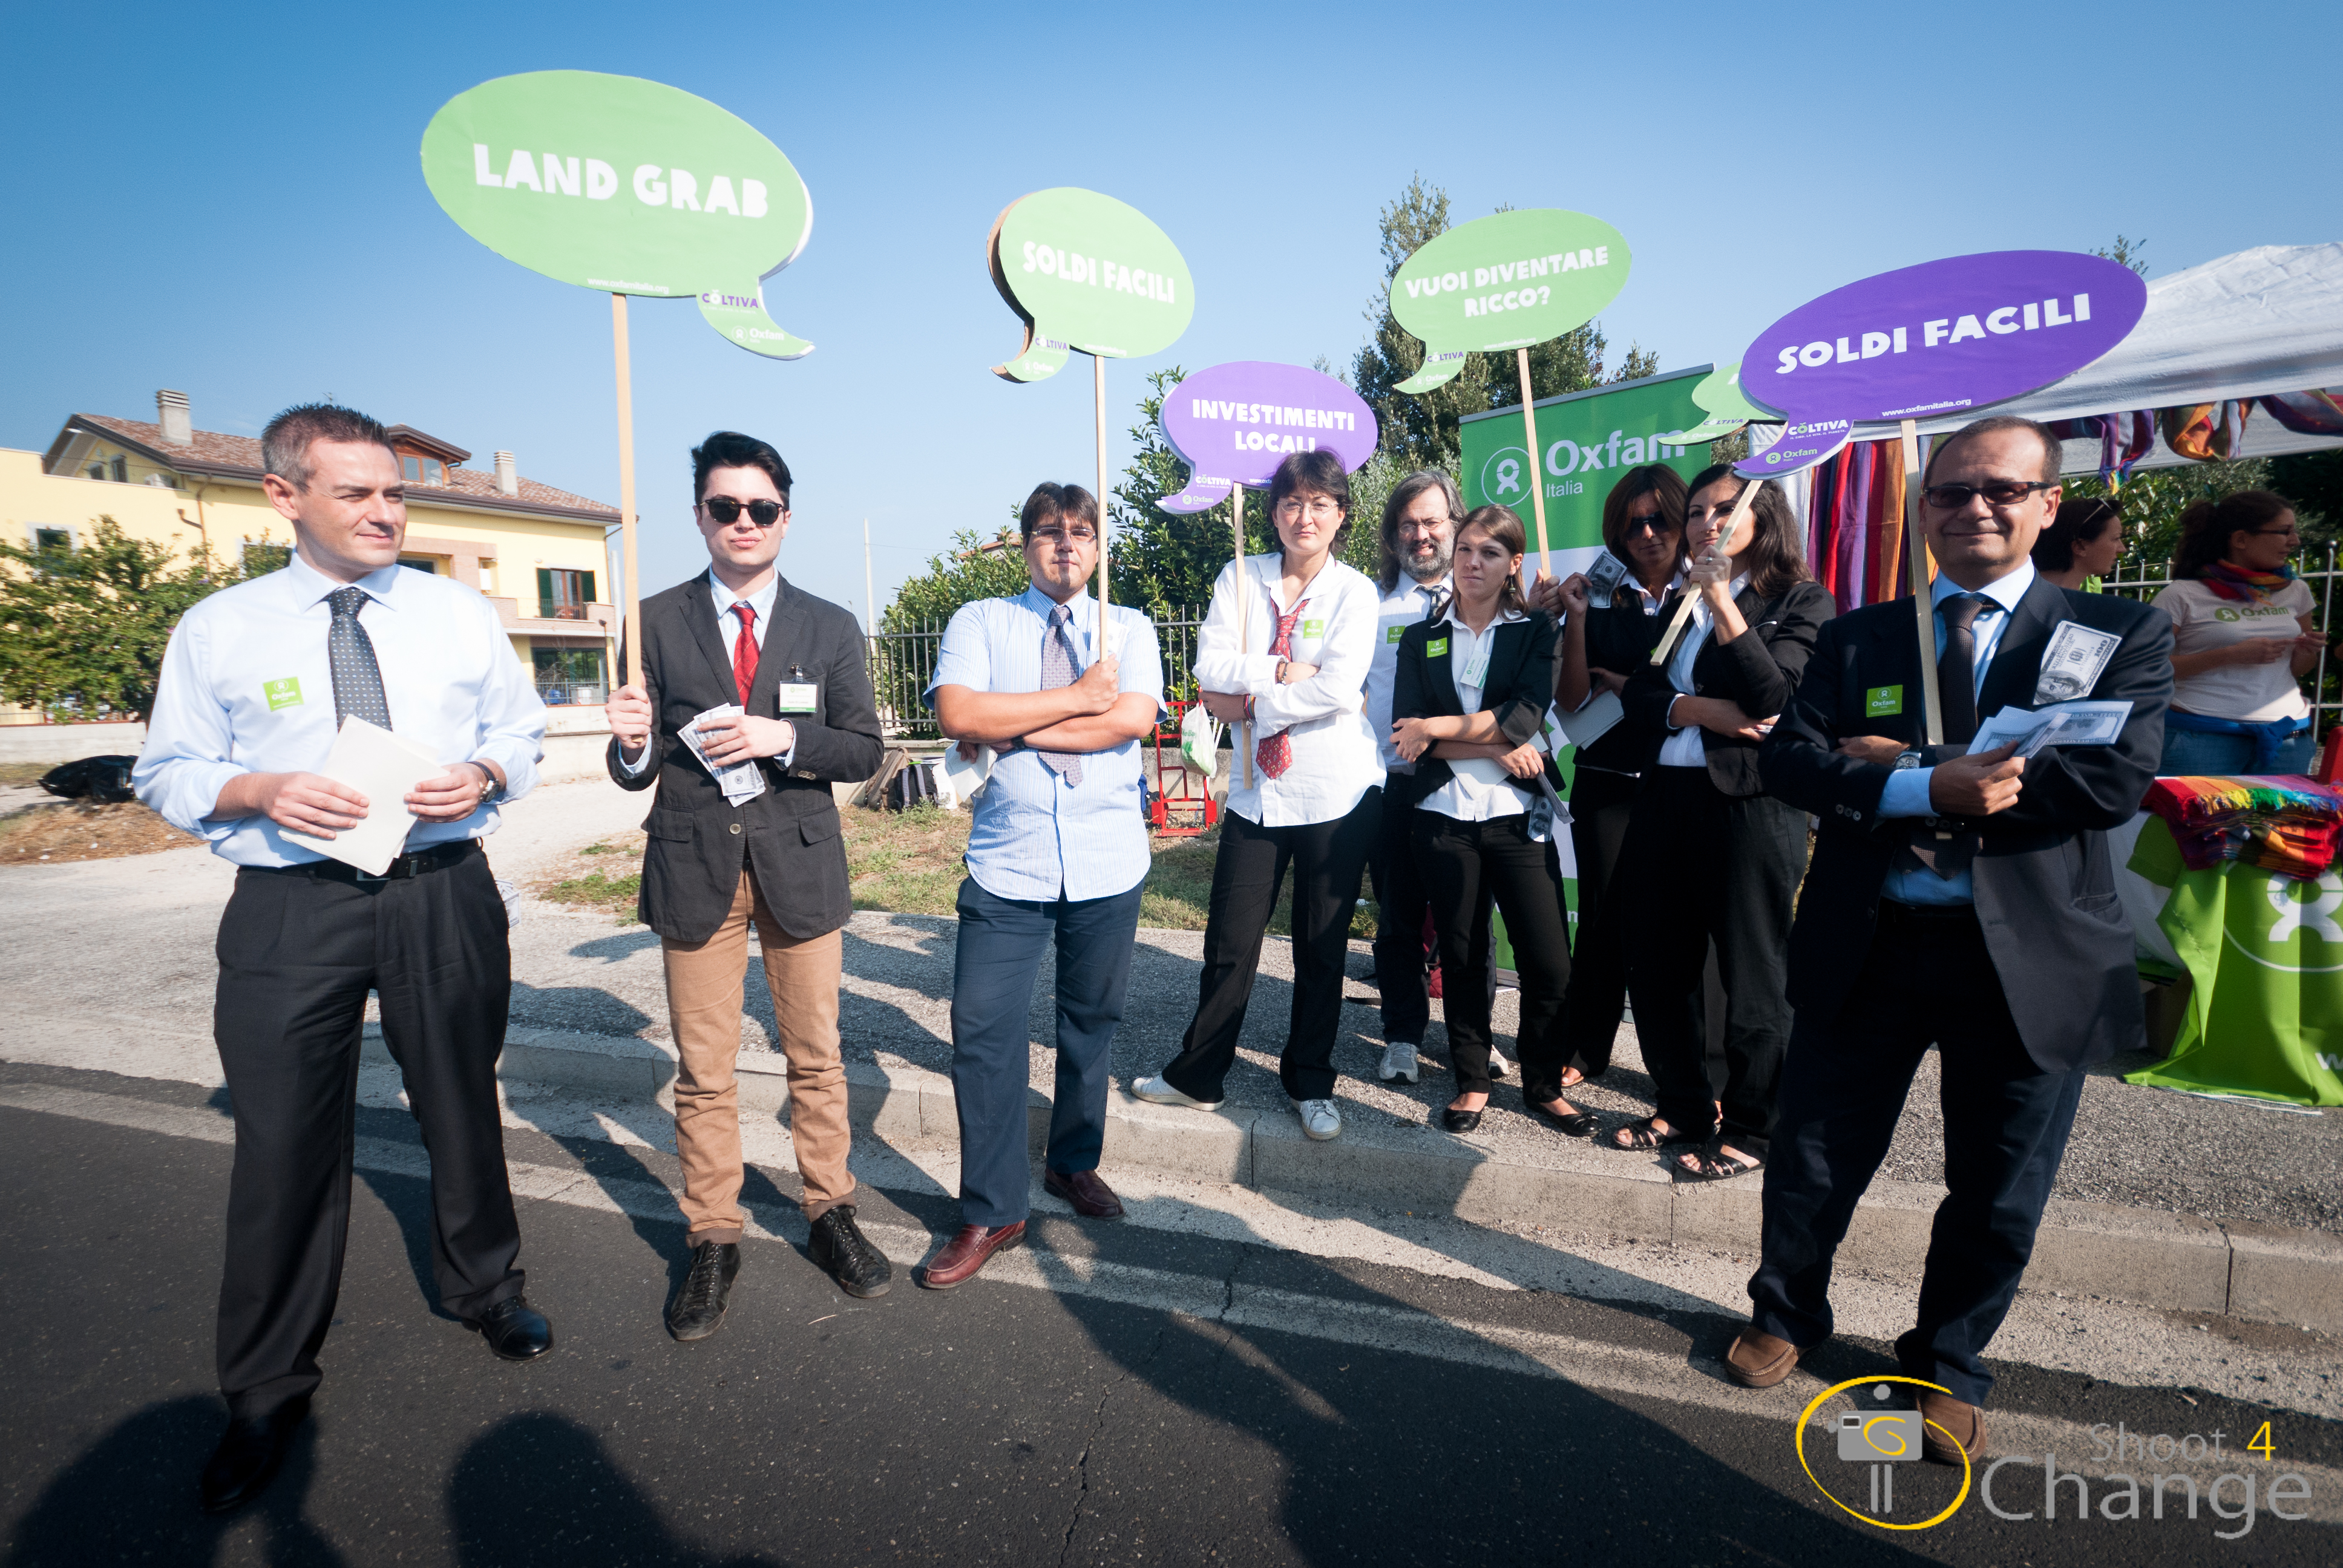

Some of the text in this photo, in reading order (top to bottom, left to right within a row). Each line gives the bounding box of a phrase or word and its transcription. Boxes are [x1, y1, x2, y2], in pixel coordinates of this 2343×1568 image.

[474, 143, 768, 218] LAND GRAB
[1023, 241, 1175, 304] SOLDI FACILI
[1404, 246, 1608, 298] VUOI DIVENTARE
[587, 278, 669, 295] www.oxfamitalia.org
[702, 289, 758, 308] COLTIVA
[1464, 286, 1551, 318] RICCO?
[749, 328, 784, 341] Oxfam
[1035, 335, 1067, 350] COLTIVA
[1776, 294, 2090, 374] SOLDI FACILI
[1427, 351, 1464, 362] COLTIVA
[1426, 374, 1449, 382] Oxfam
[1193, 399, 1354, 431] INVESTIMENTI
[1882, 399, 1971, 417] www.oxfamitalia.org
[1788, 419, 1848, 436] COLTIVA
[1235, 431, 1315, 453] LOCALI
[1783, 449, 1818, 459] Oxfam
[1195, 474, 1231, 486] COLTIVA
[1546, 482, 1583, 498] Italia
[1193, 495, 1214, 503] Oxfam
[2241, 607, 2289, 616] Oxfam
[2094, 639, 2108, 658] 100
[272, 691, 296, 700] Oxfam
